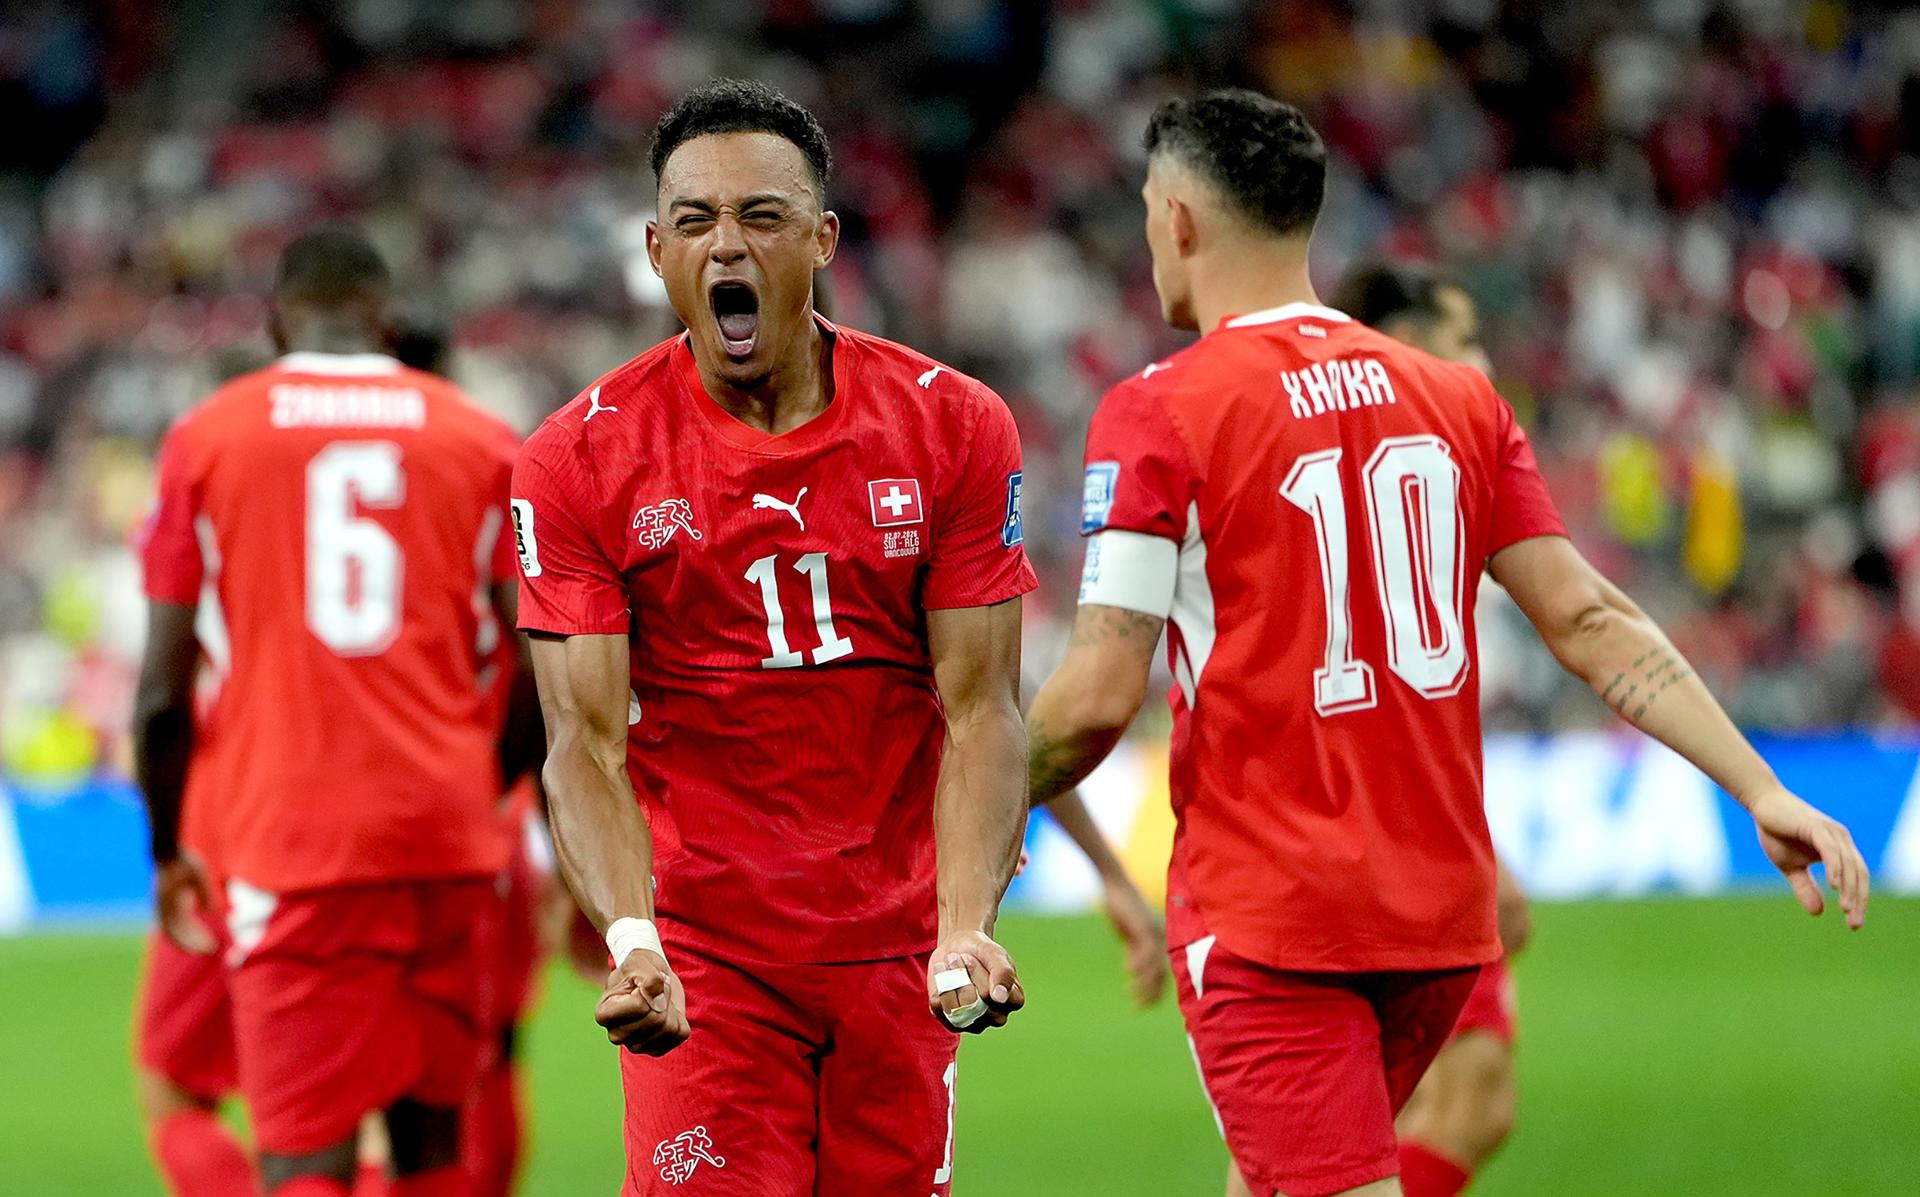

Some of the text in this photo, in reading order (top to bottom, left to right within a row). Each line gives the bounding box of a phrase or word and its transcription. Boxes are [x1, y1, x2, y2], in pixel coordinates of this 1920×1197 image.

[304, 439, 407, 657] 6
[883, 539, 897, 550] SUI
[904, 537, 920, 548] ALG
[884, 547, 920, 558] VANCOUVER
[1279, 434, 1470, 717] 10
[743, 551, 855, 669] 11
